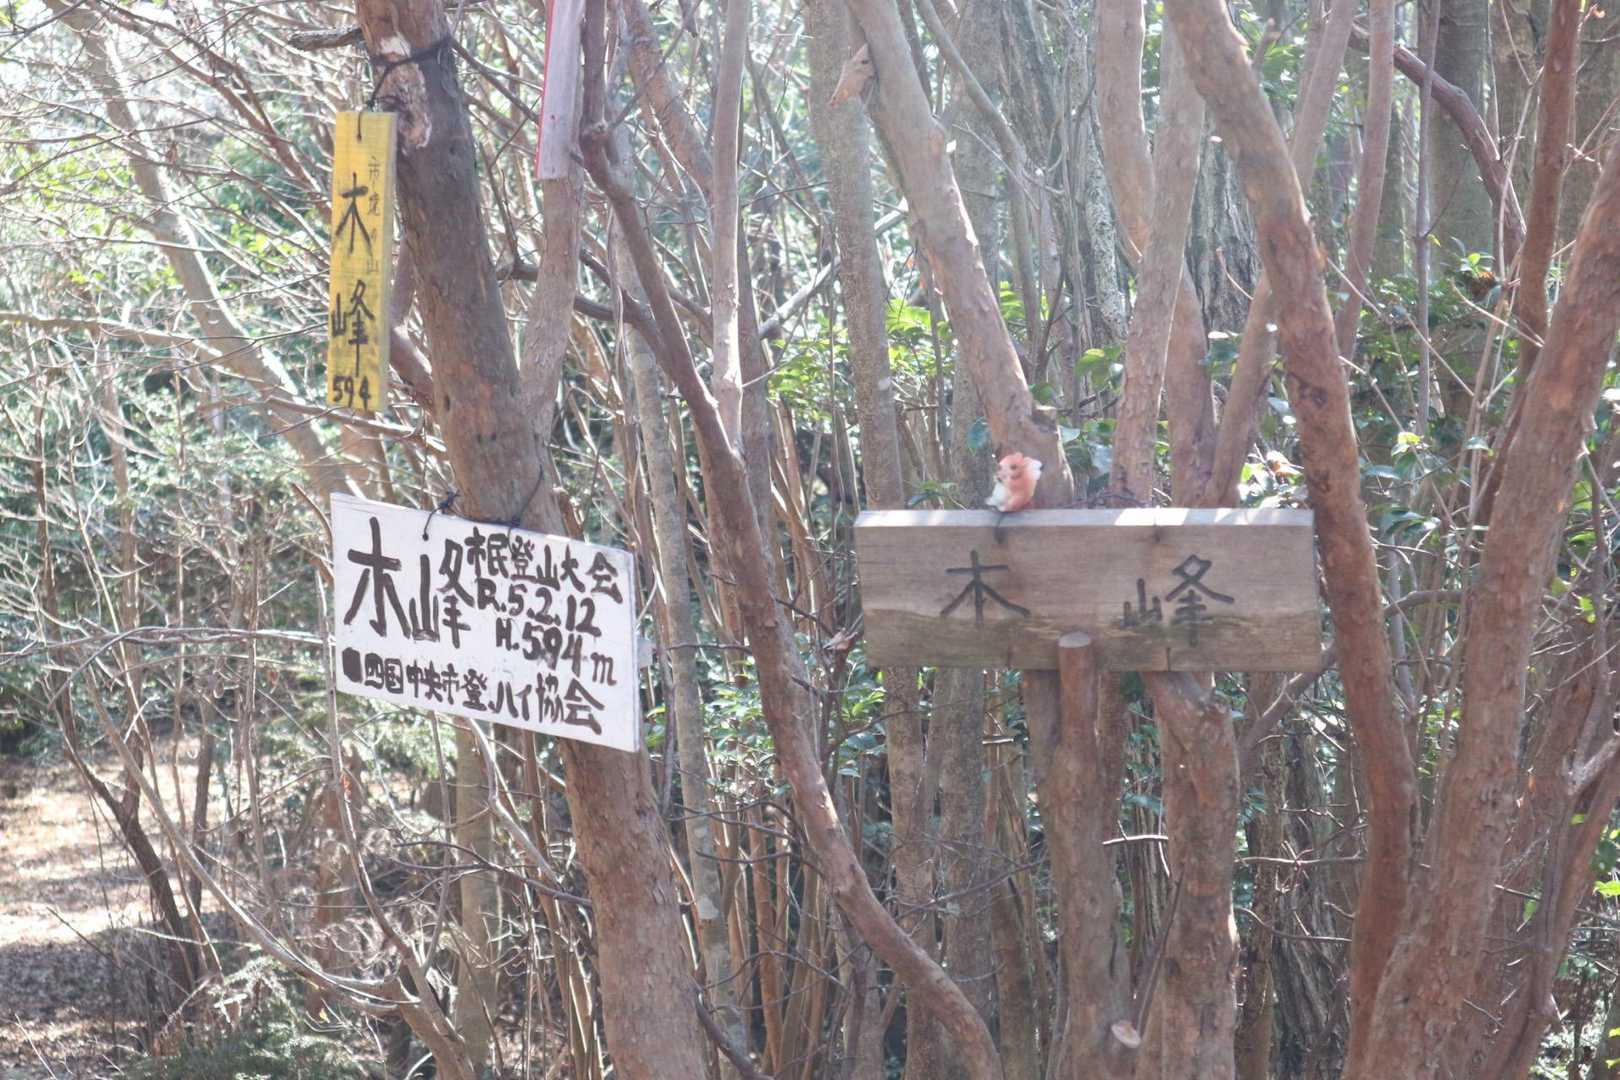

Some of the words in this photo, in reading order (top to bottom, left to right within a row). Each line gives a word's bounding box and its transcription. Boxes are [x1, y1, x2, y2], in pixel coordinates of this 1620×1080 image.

[331, 171, 375, 378] 木峰
[332, 375, 371, 412] 594
[465, 526, 623, 603] 市民登山大会
